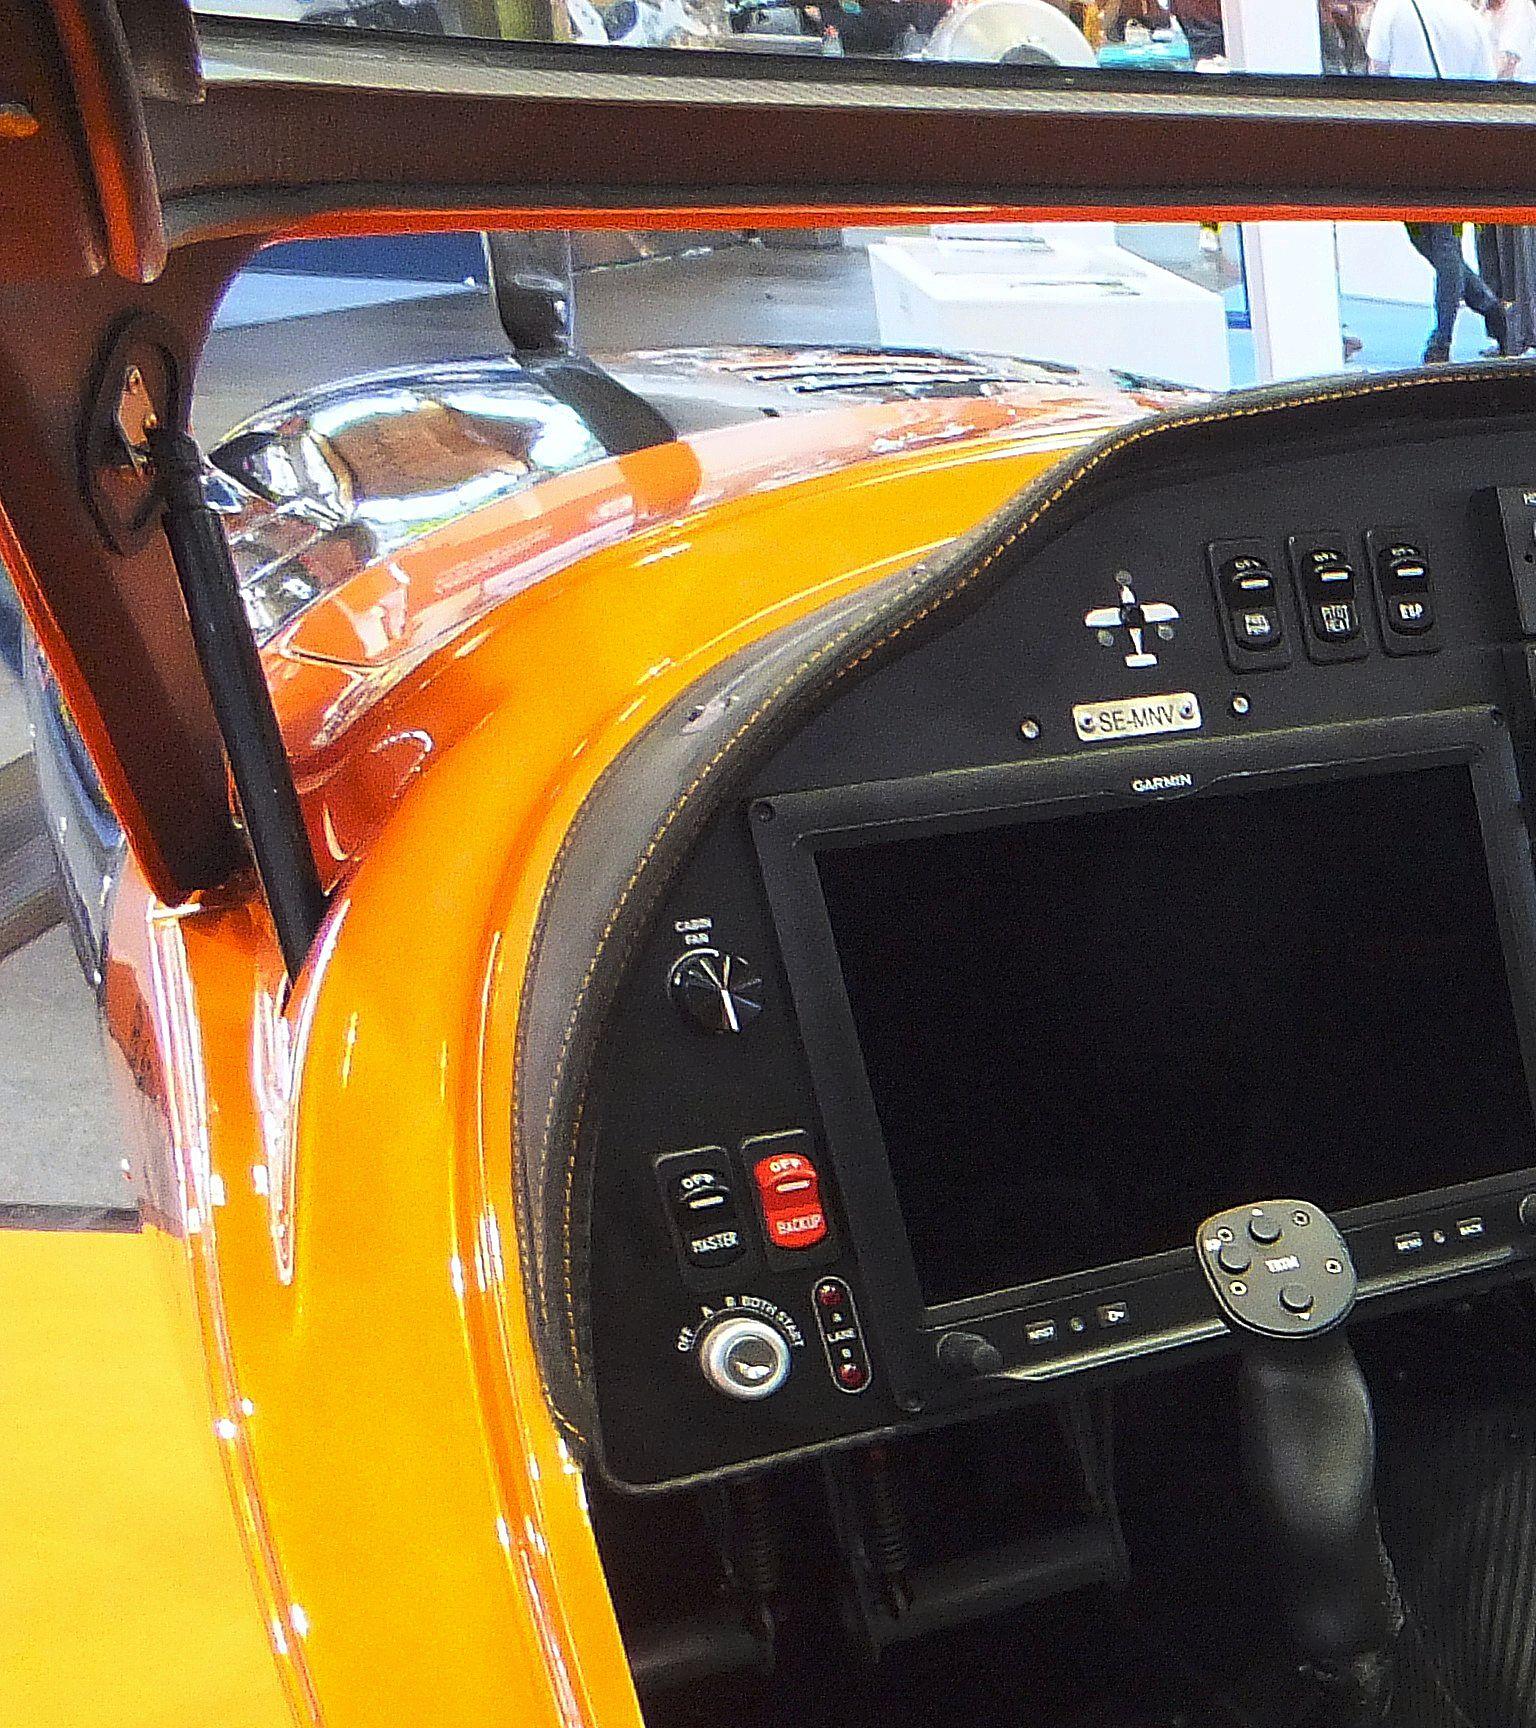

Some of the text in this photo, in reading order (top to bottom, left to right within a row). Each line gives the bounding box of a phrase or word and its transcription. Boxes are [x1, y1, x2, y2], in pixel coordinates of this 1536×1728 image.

[1099, 704, 1174, 732] SE-MNV
[1132, 773, 1192, 792] GARMIN
[769, 1157, 802, 1173] OFF
[681, 1173, 715, 1189] OFF
[776, 1213, 822, 1235] BACKUP
[691, 1231, 739, 1254] MASTER
[701, 1306, 714, 1319] A
[741, 1295, 778, 1316] BOTH
[677, 1326, 695, 1351] OFF
[776, 1311, 806, 1347] START
